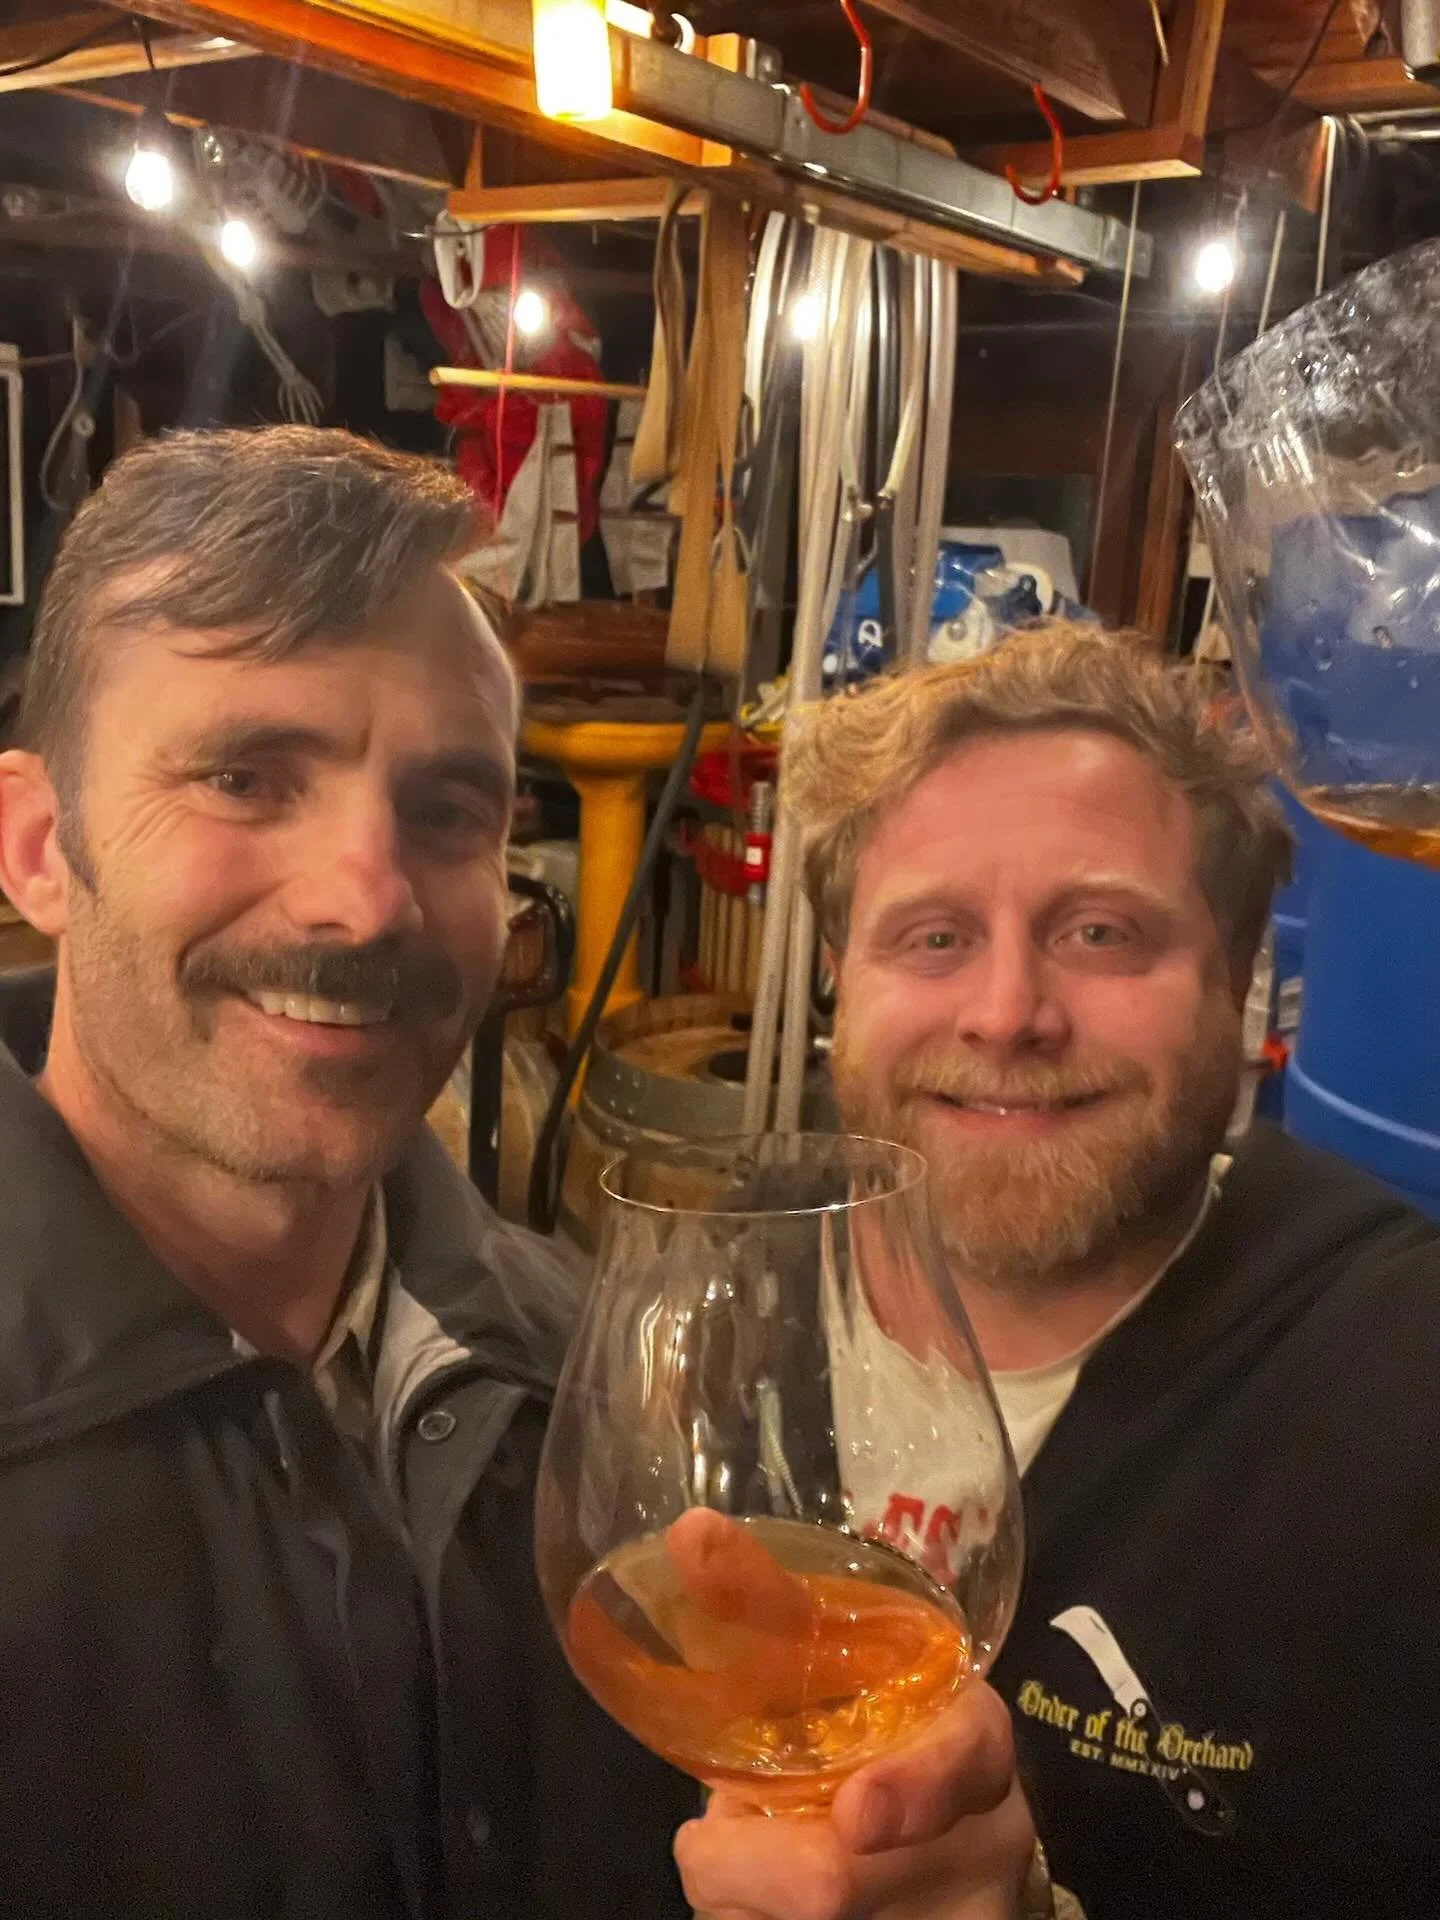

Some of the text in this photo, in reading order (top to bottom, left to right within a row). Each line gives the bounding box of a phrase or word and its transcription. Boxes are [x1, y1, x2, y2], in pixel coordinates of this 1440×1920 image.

[1018, 1681, 1253, 1770] Order of the Orchard
